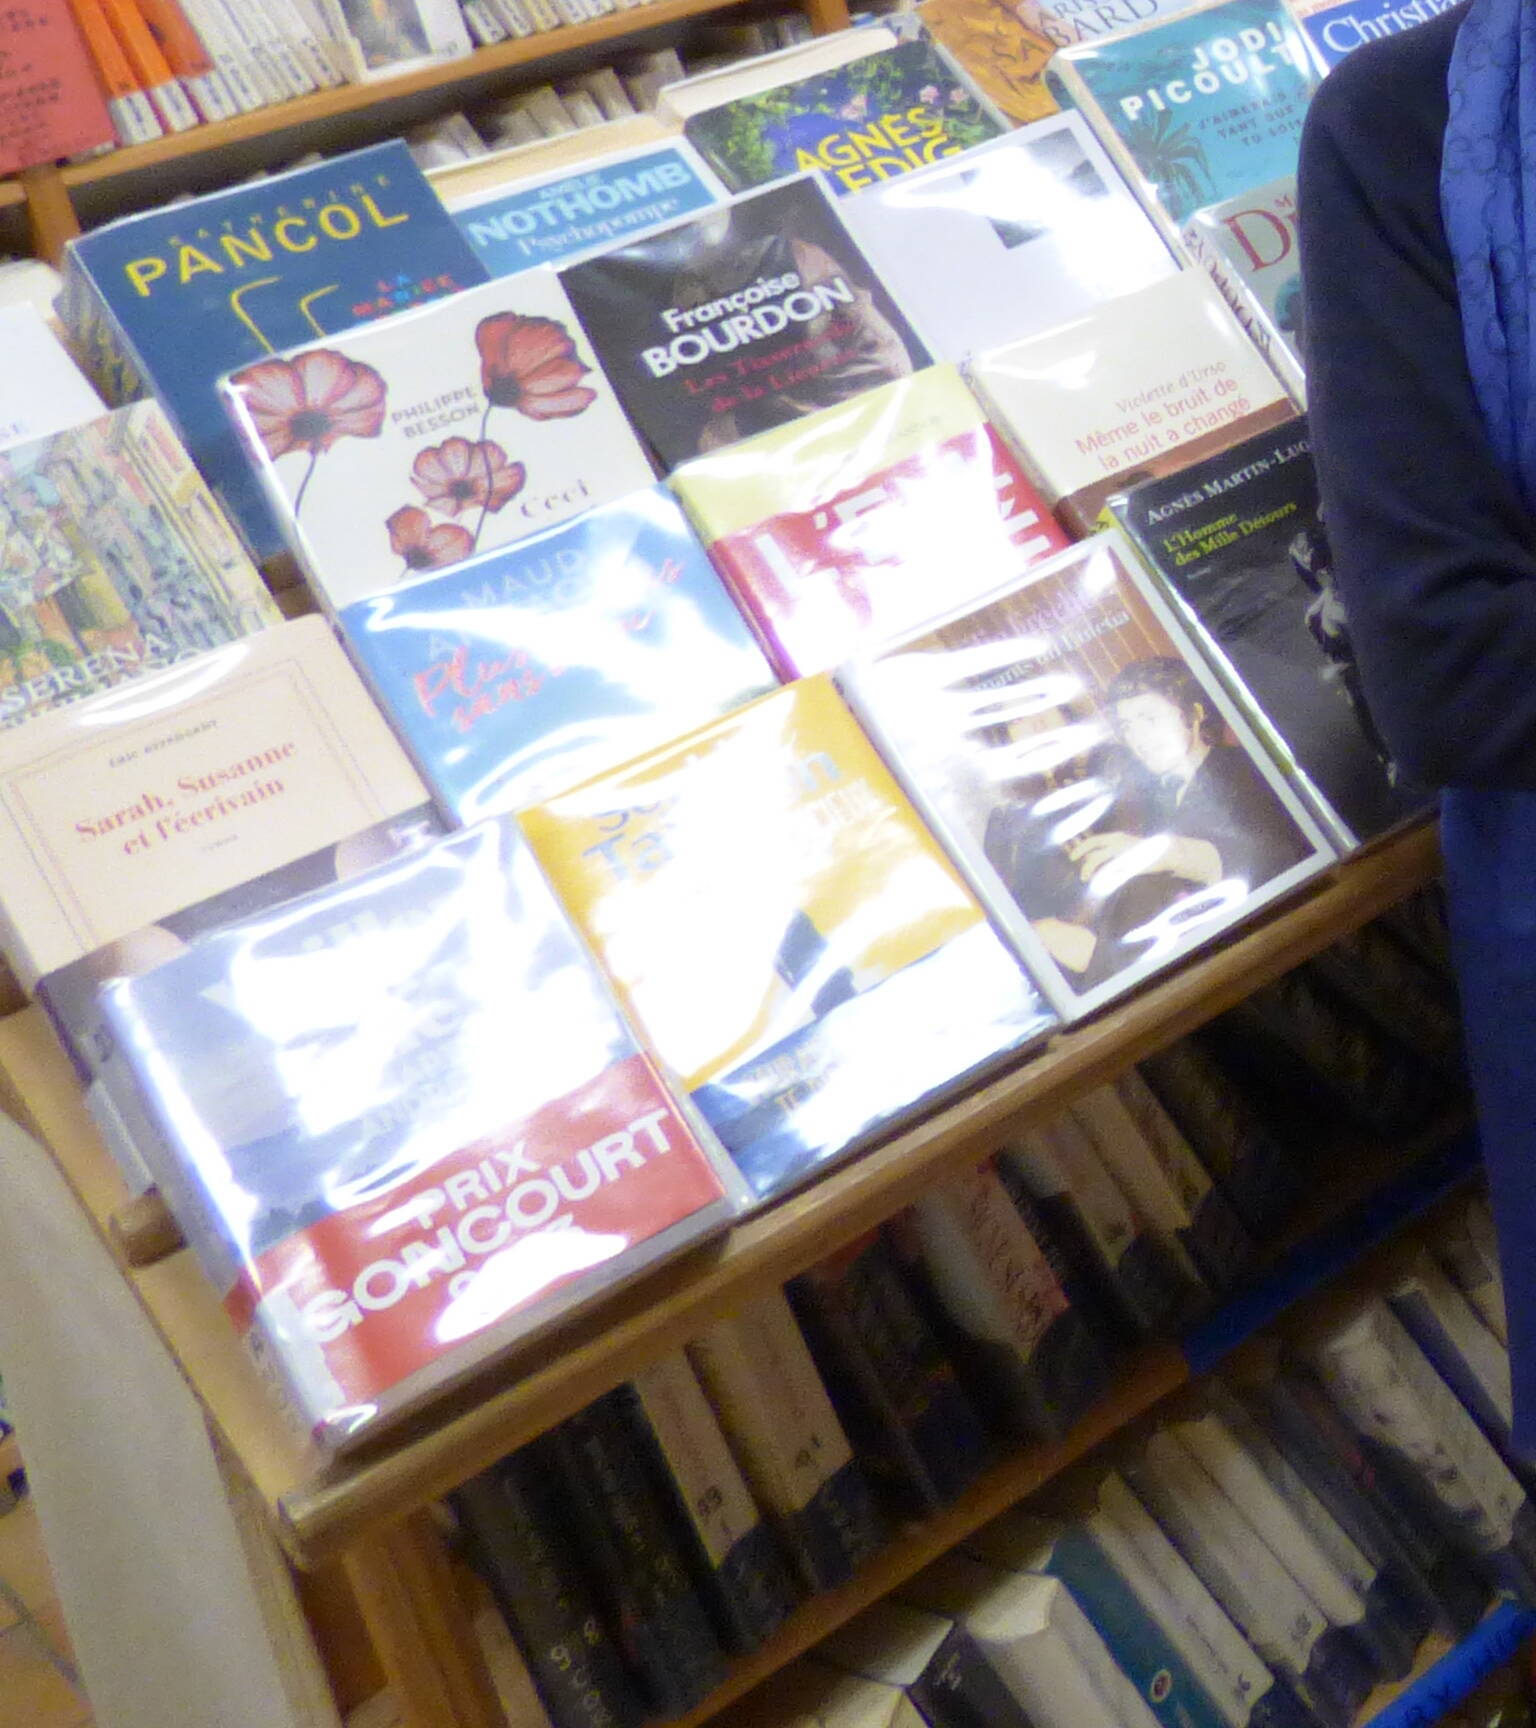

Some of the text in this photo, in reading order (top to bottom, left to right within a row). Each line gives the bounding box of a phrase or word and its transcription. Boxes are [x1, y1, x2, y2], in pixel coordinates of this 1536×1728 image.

[1118, 43, 1298, 122] PICOULT
[1189, 18, 1284, 72] JODI
[836, 130, 964, 194] EDIG
[1268, 119, 1300, 140] SOI
[465, 160, 694, 249] NOTHOMB
[123, 192, 411, 299] PANCOL
[640, 276, 856, 379] BOURDON
[660, 269, 801, 336] Françoise
[402, 402, 482, 441] BESSON
[1073, 376, 1239, 457] Même le bruit de
[1099, 451, 1121, 472] la
[1122, 435, 1163, 464] nuit
[1181, 395, 1252, 437] changé
[1162, 509, 1240, 554] L'Homme
[74, 741, 297, 839] Sarah, Susanne
[122, 776, 286, 857] et l'écrivain
[411, 1139, 547, 1229] PRIX
[296, 1104, 675, 1346] GONCOURT
